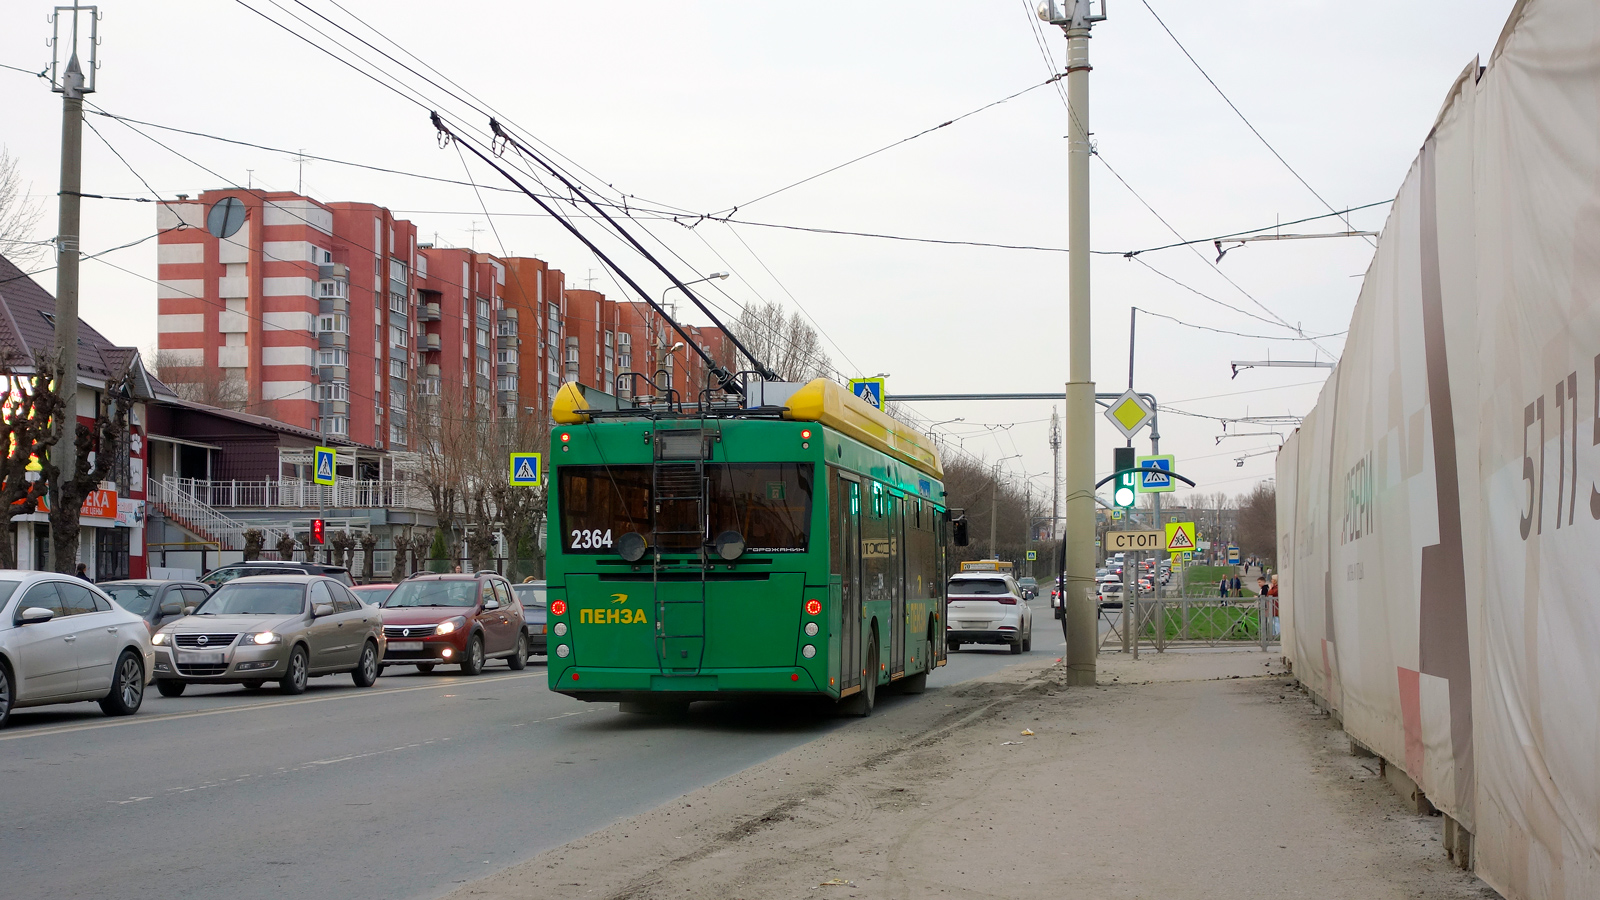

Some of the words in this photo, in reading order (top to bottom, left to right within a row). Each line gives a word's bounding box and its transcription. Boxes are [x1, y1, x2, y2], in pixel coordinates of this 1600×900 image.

[83, 491, 110, 508] ЕКА
[571, 528, 613, 549] 2364
[1116, 534, 1157, 547] СТОП
[579, 608, 648, 624] ПЕНЗА
